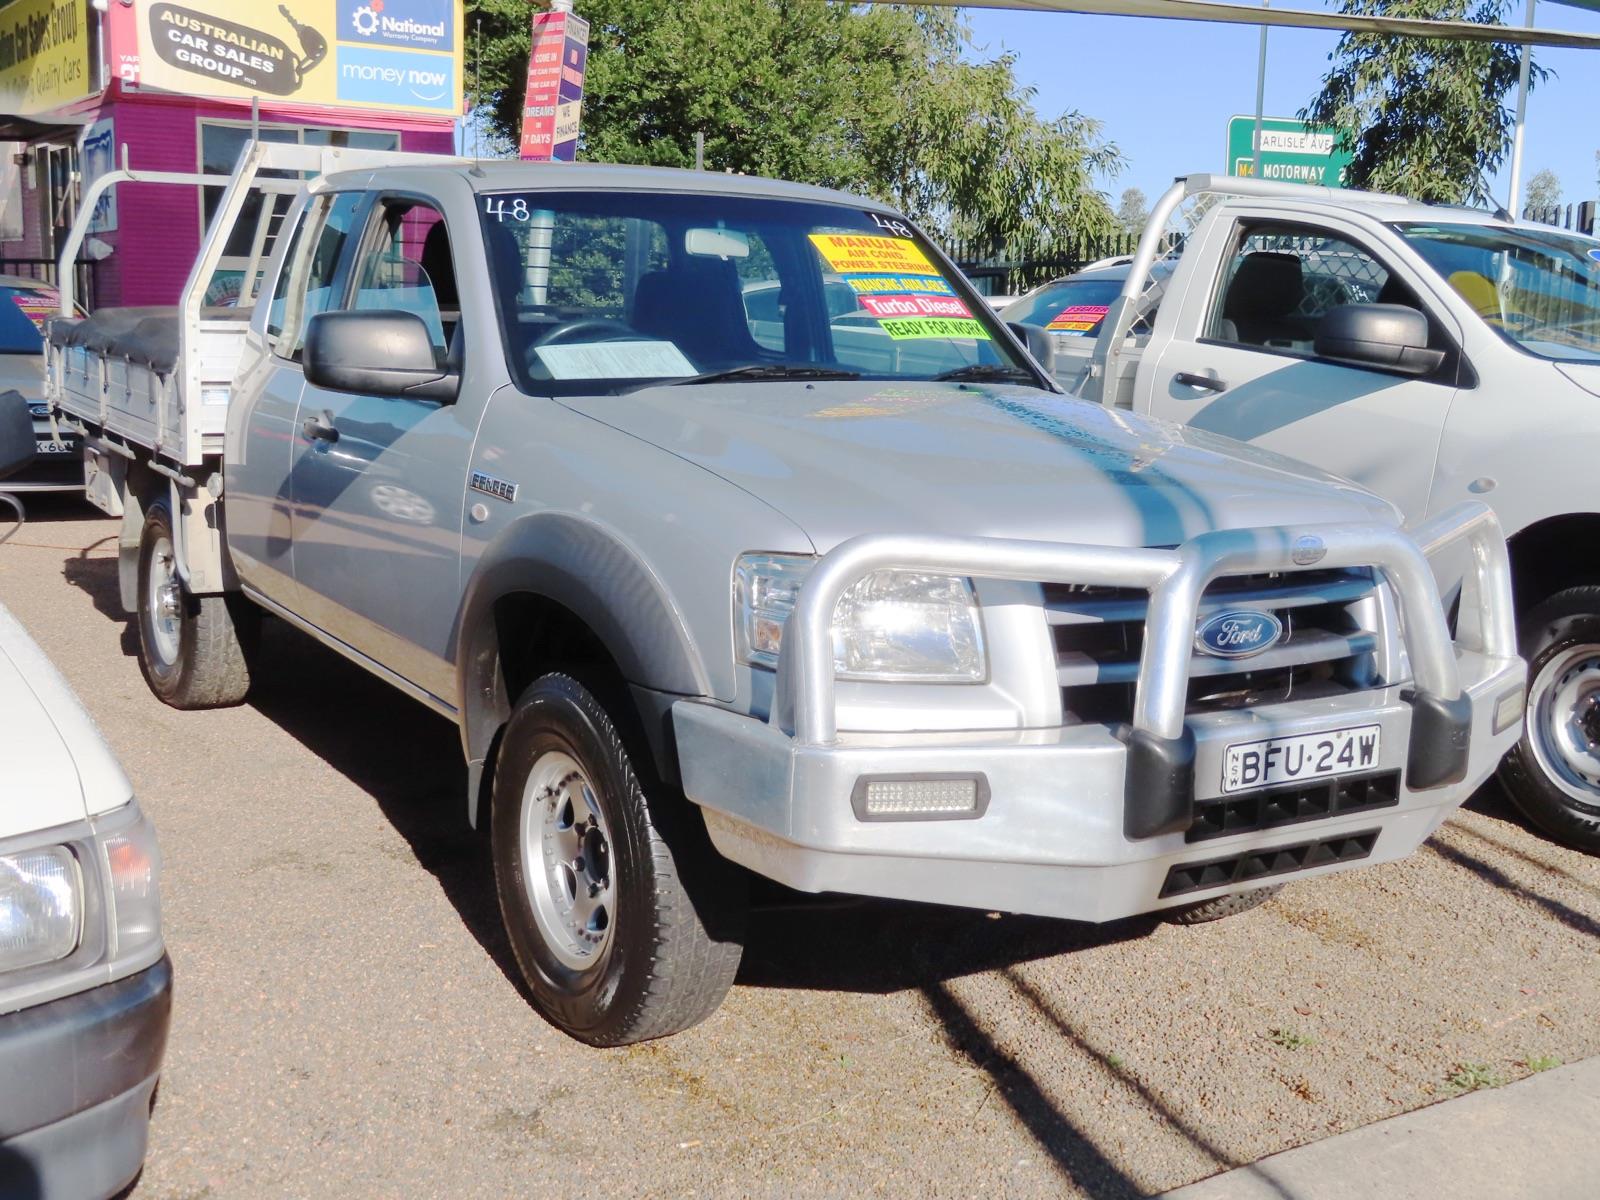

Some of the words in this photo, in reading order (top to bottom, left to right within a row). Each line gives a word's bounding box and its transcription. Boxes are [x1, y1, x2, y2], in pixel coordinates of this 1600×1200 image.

[161, 10, 284, 61] AUSTRALIAN
[381, 16, 445, 37] National
[168, 29, 209, 53] CAR
[213, 44, 275, 74] SALES
[63, 55, 81, 84] Cars
[175, 48, 244, 79] GROUP
[342, 63, 406, 86] money
[408, 70, 447, 86] now
[526, 106, 555, 117] DREAMS
[530, 133, 552, 144] DAYS
[1258, 135, 1306, 149] ARLISLE
[1240, 164, 1254, 176] M4
[1263, 164, 1326, 180] MOTORWAY
[486, 197, 530, 222] 48
[871, 213, 914, 238] 48
[829, 236, 905, 251] MANUAL
[848, 249, 873, 257] AIR
[872, 249, 908, 260] COND.
[832, 260, 876, 269] POWER
[880, 260, 934, 273] STEERING
[865, 298, 918, 314] Turbo
[915, 298, 967, 315] Diesel
[882, 321, 926, 336] READY
[925, 320, 954, 336] FOR
[948, 320, 986, 337] WORK
[1216, 618, 1263, 645] Ford
